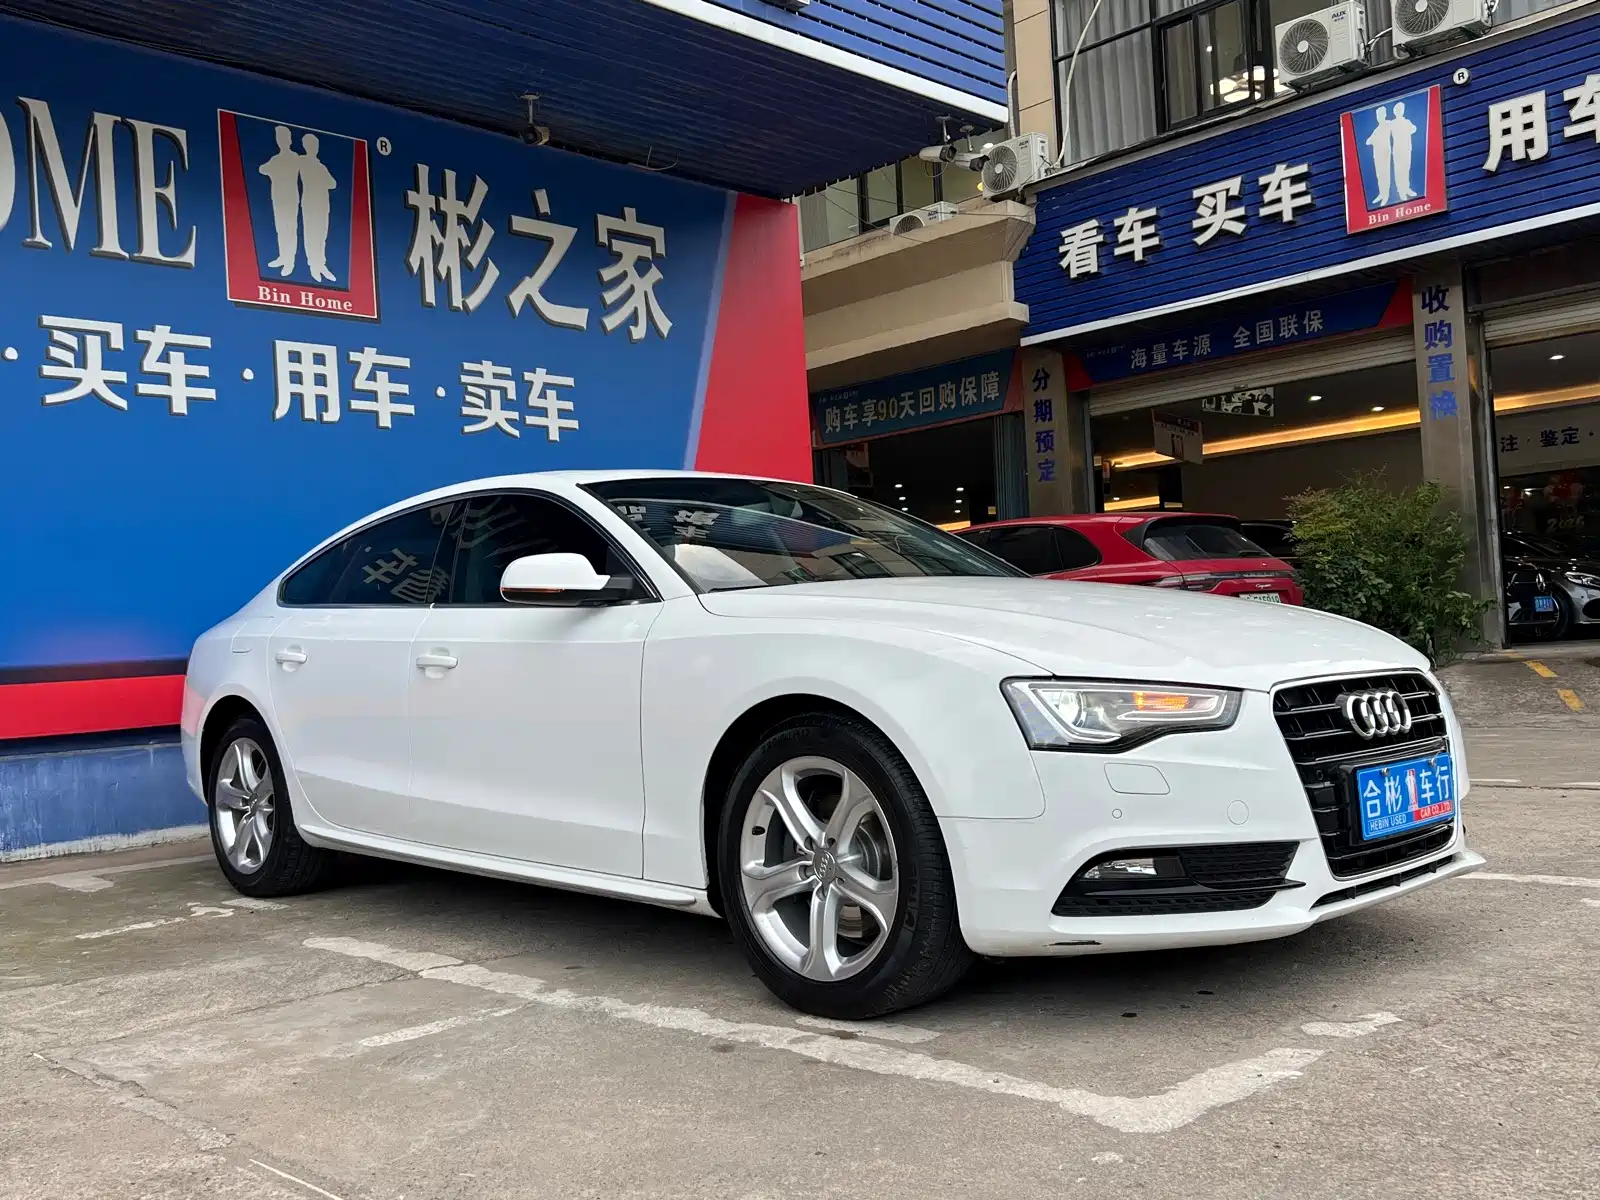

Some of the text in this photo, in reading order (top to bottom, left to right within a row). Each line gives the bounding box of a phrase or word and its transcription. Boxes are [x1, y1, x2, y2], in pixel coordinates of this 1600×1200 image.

[0, 96, 196, 270] ME
[1368, 203, 1432, 225] Bin Home
[1058, 162, 1313, 280] 看车 买车
[404, 163, 674, 343] 彬之家
[257, 285, 354, 312] Bin Home
[1130, 333, 1213, 370] 海量车源
[1232, 308, 1324, 349] 全国联保
[1420, 284, 1459, 420] 收购置换
[824, 370, 1001, 435] 购车享90天回购保障
[1369, 813, 1407, 832] HEBIN USED
[1420, 806, 1432, 819] CAR
